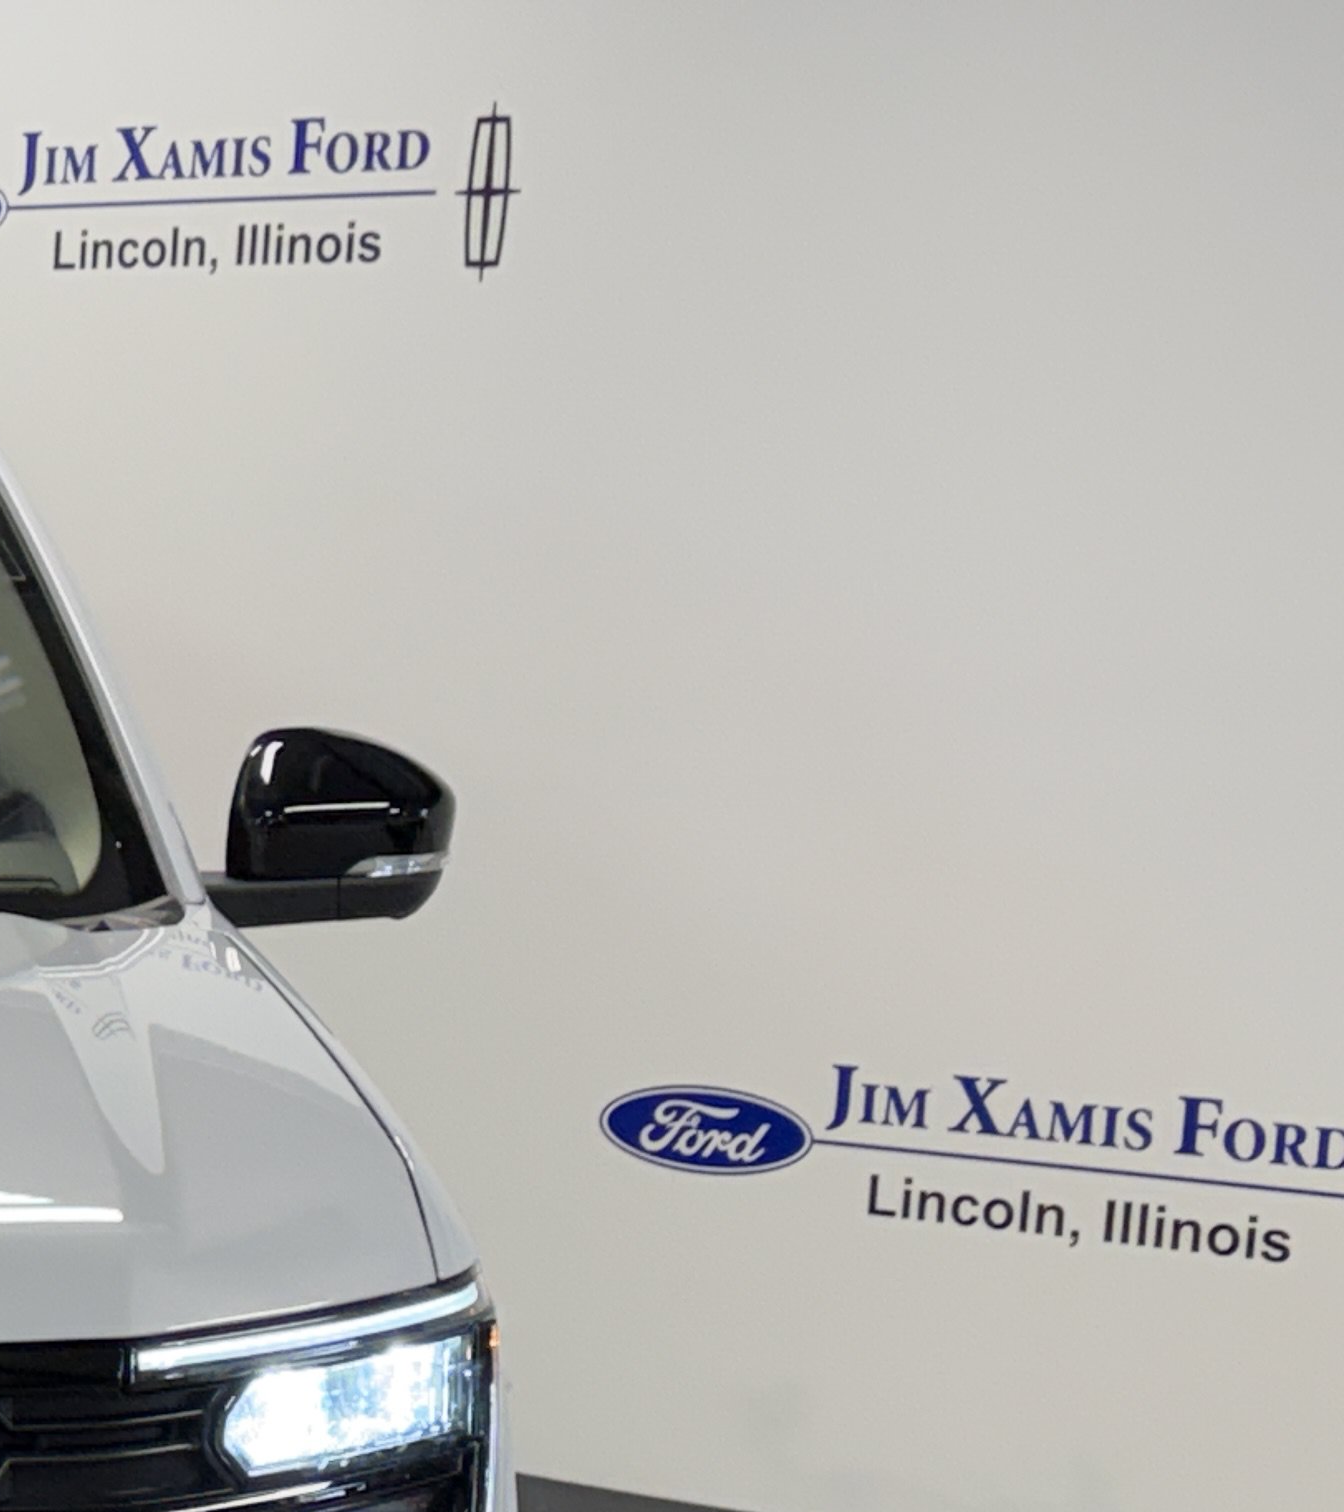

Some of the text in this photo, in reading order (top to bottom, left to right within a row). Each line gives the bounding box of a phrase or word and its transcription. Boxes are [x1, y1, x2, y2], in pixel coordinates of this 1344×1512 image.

[52, 220, 382, 274] Lincoln, Illinois
[639, 1098, 766, 1164] Ford
[866, 1173, 1293, 1264] Lincoln, Illinois
